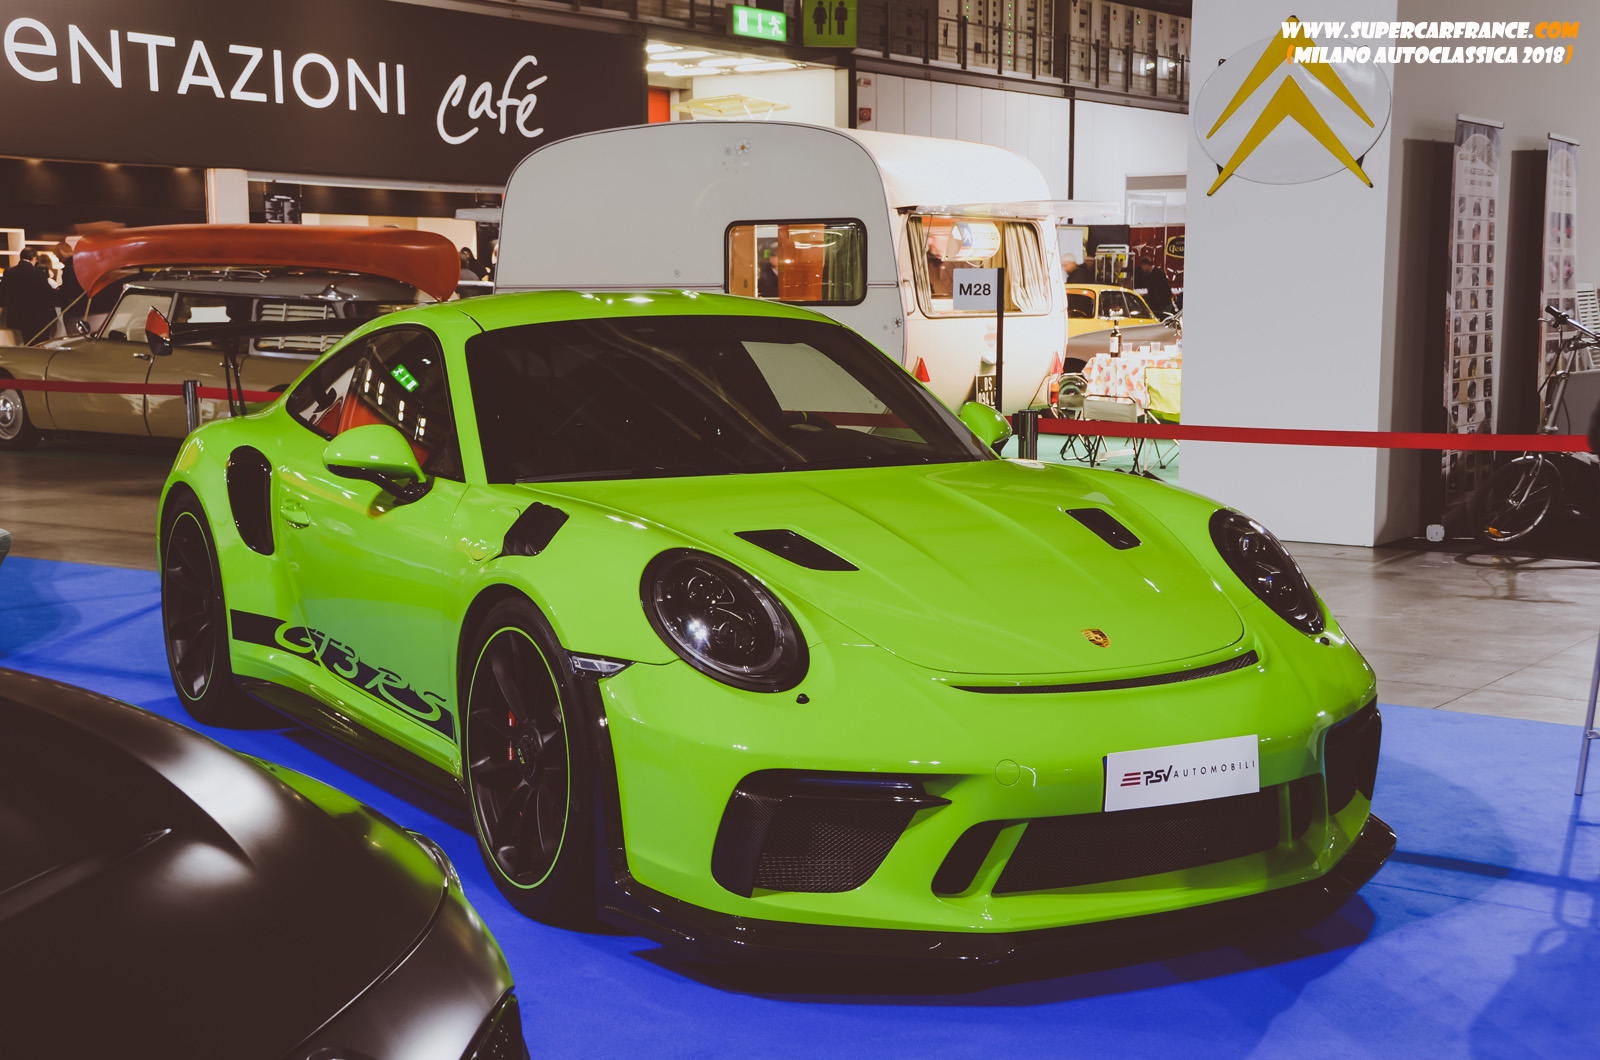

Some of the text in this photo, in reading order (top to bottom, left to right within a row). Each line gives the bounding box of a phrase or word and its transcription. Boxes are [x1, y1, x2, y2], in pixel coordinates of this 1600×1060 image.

[959, 283, 992, 296] M28
[274, 623, 447, 722] GT3 RS
[1143, 760, 1255, 786] PSV AUTOMOBILI
